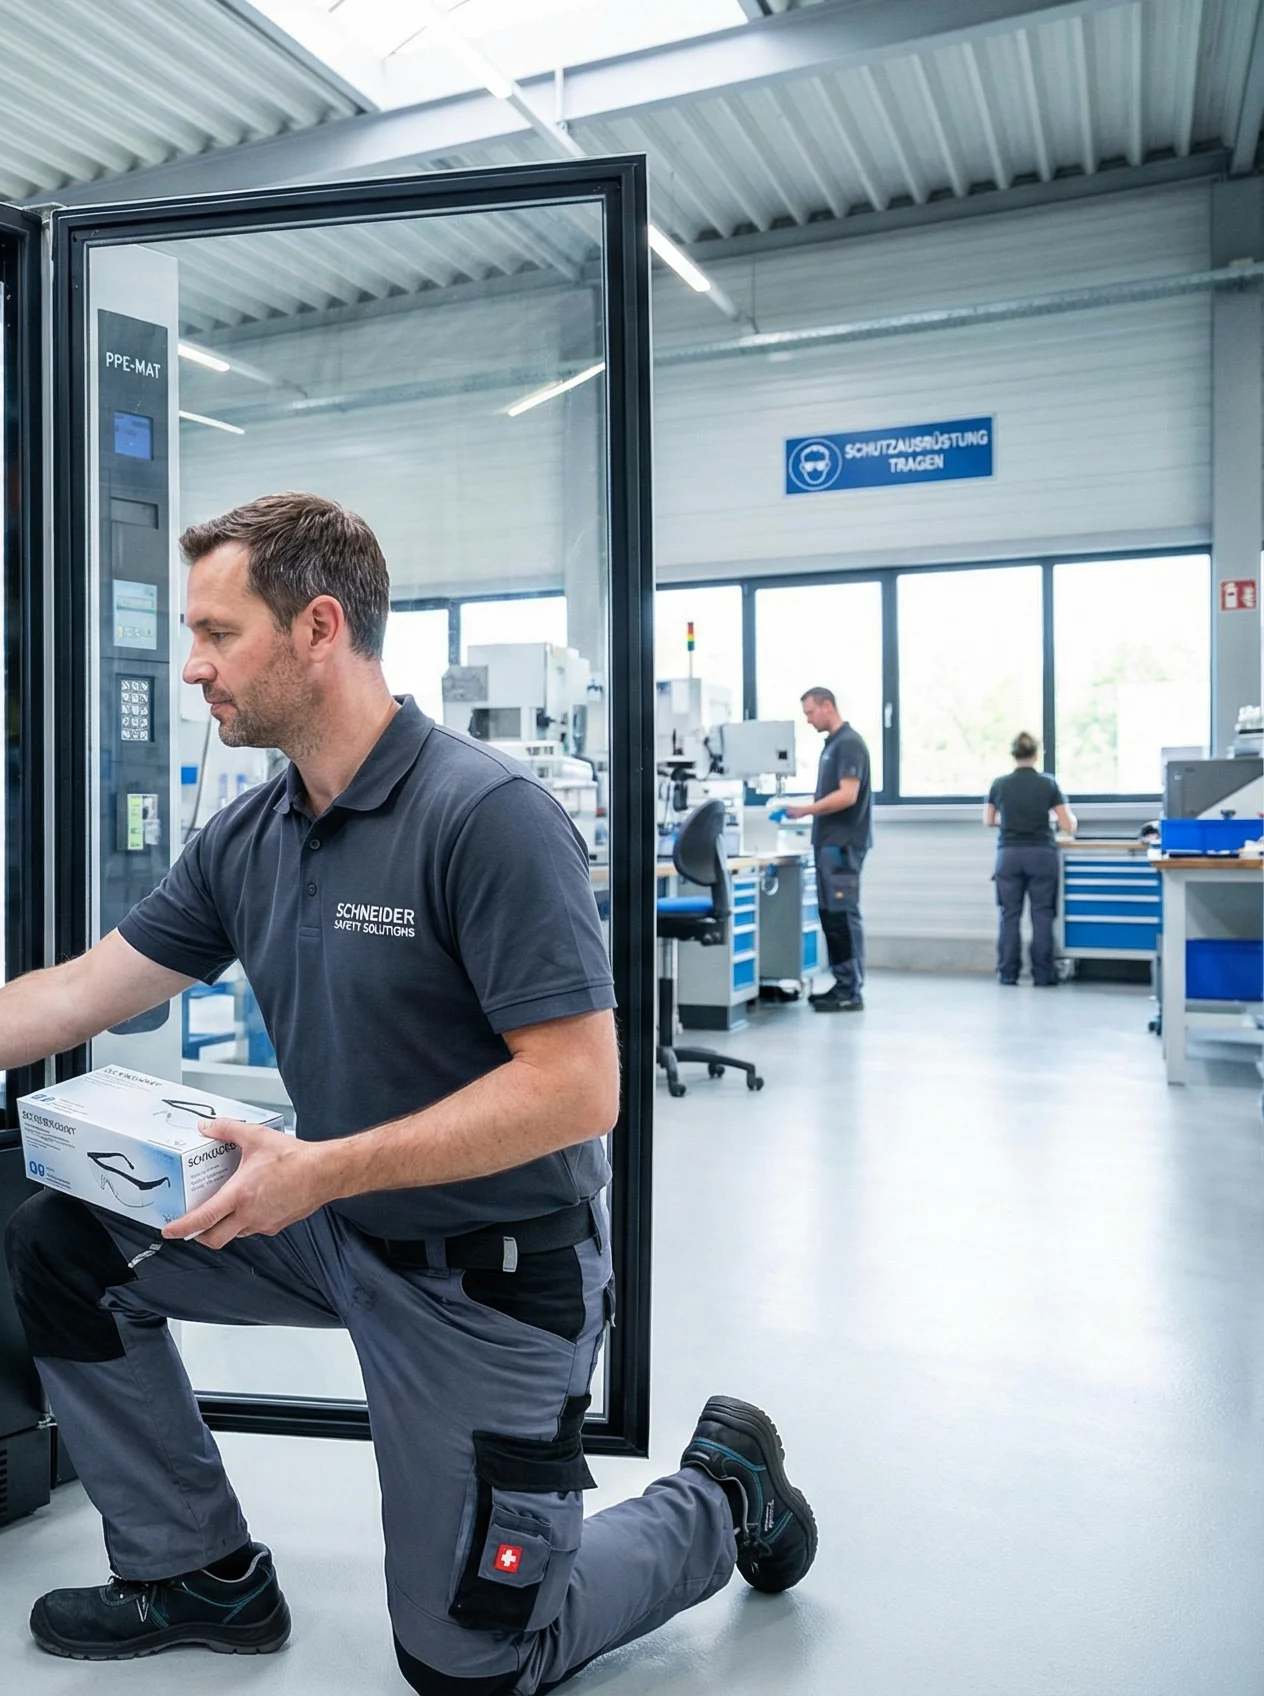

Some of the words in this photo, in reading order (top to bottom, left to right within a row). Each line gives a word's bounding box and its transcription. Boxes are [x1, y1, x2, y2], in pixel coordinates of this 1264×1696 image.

[106, 351, 161, 379] PPE-MAT
[844, 430, 989, 459] SCHUTZAUSRÜSTUNG
[888, 453, 944, 473] TRAGEN
[336, 902, 415, 925] SCHNEIDER
